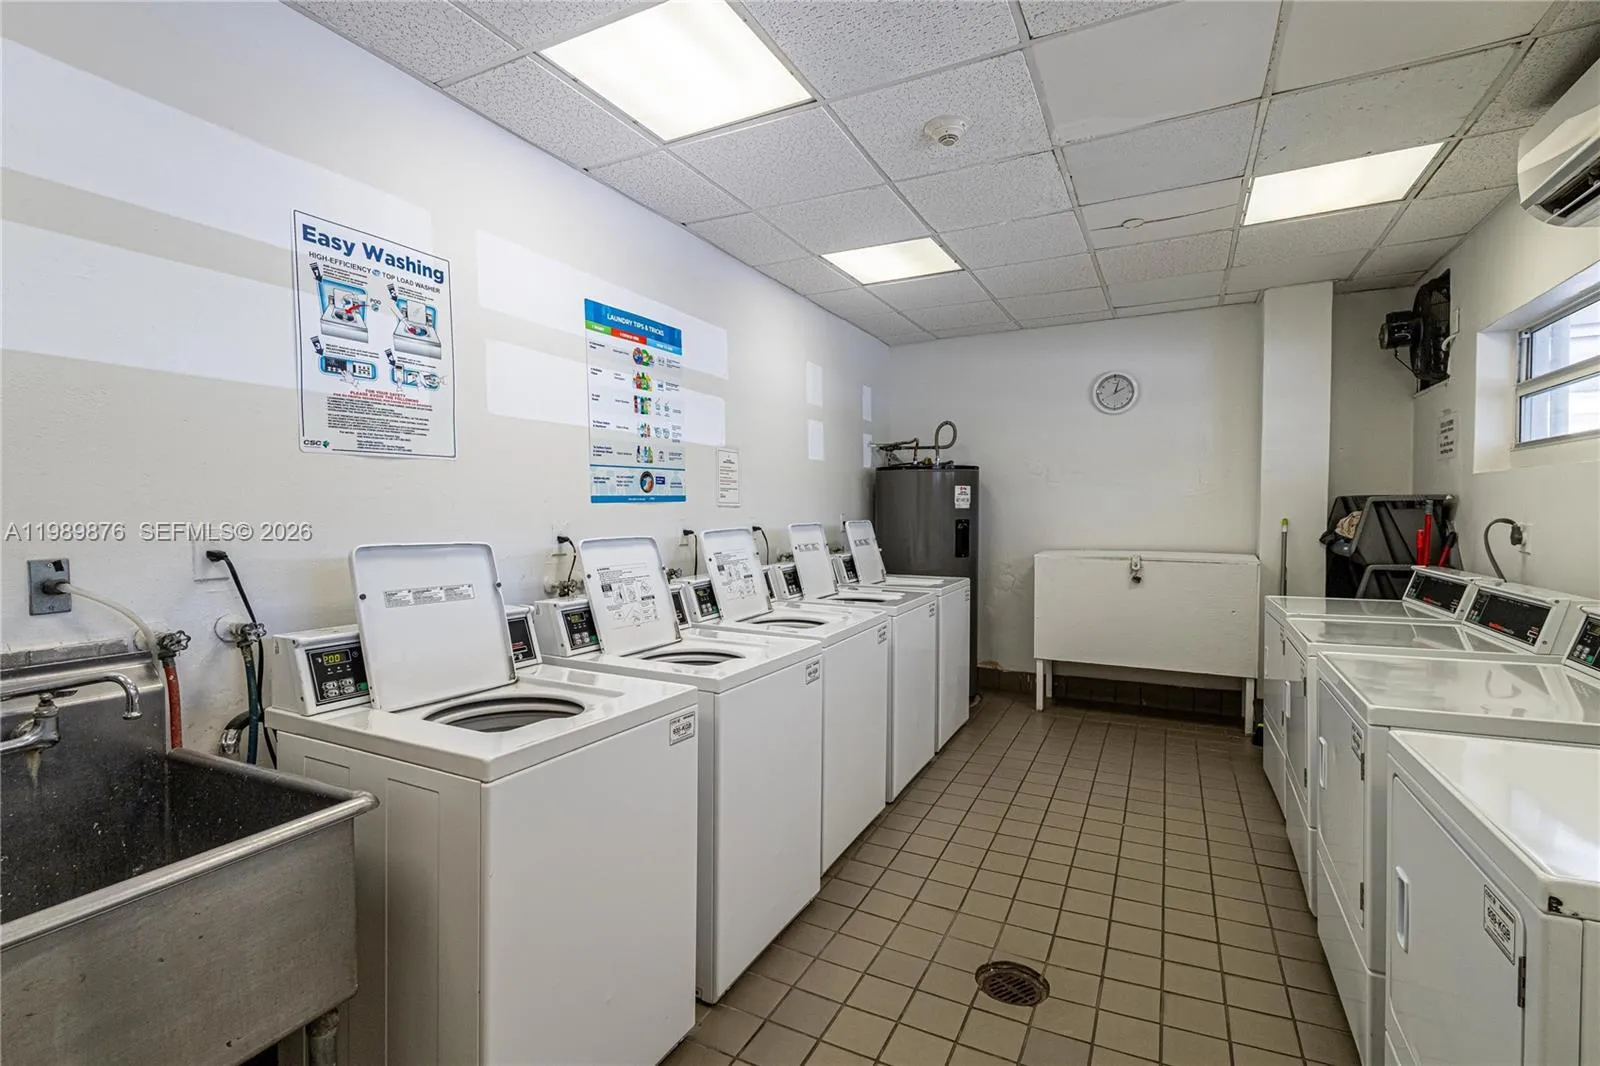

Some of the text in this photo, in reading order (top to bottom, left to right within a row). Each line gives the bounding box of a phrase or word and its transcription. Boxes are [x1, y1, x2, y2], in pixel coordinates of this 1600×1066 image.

[302, 223, 356, 257] Easy
[362, 242, 445, 285] Washing
[308, 251, 372, 274] HIGH-EFFICIENCY
[382, 271, 396, 281] TOP
[396, 276, 414, 287] LOAD
[415, 281, 441, 294] WASHER
[606, 313, 633, 327] LAUNDRY
[633, 320, 645, 330] TIPS
[649, 325, 665, 337] TRICKS
